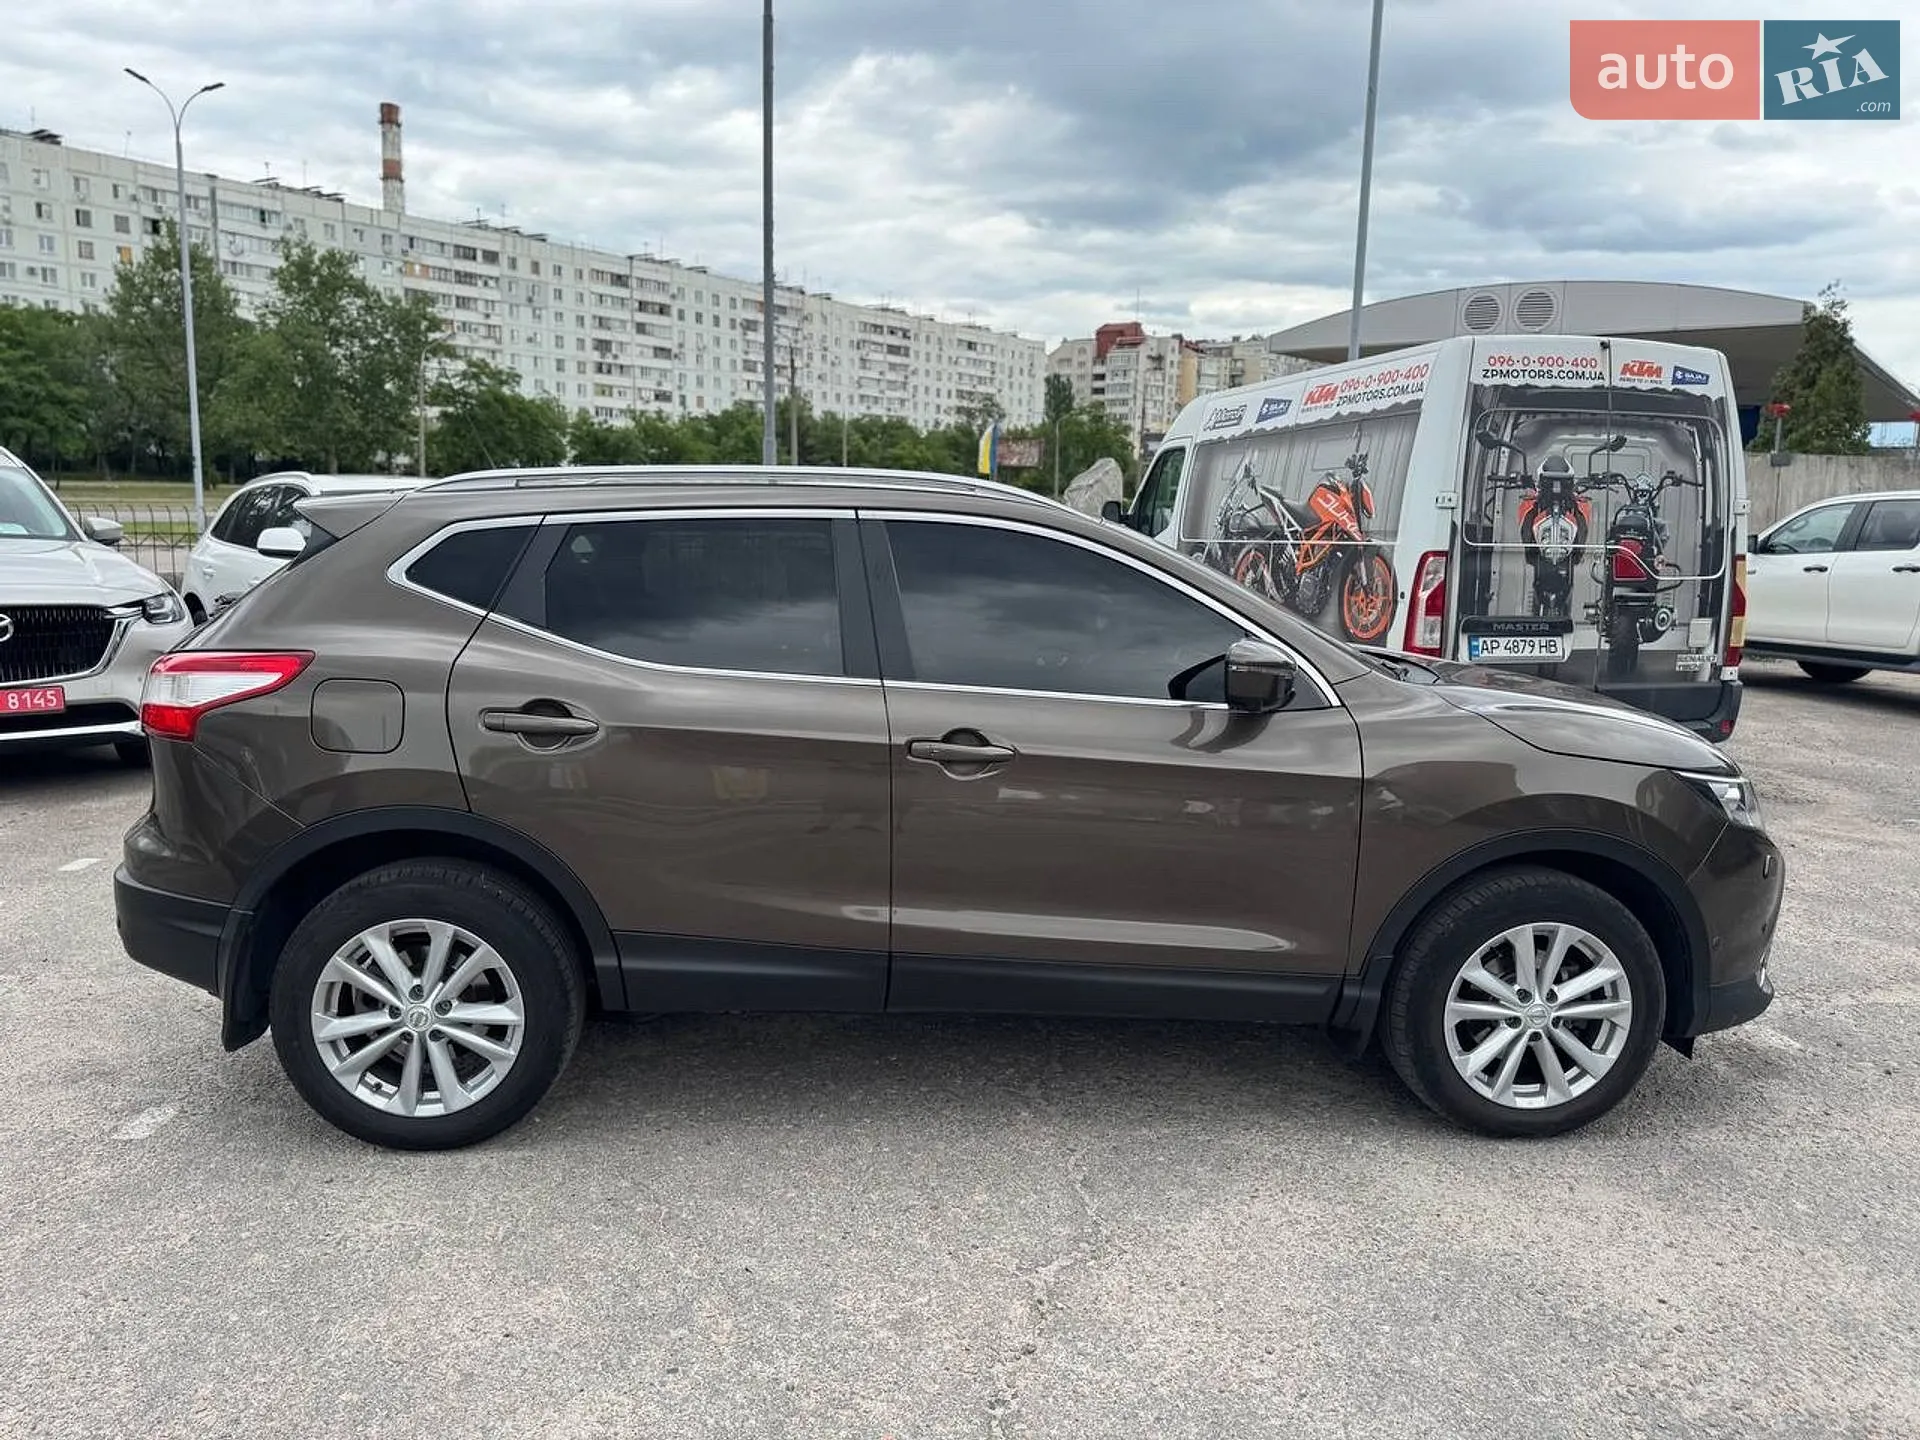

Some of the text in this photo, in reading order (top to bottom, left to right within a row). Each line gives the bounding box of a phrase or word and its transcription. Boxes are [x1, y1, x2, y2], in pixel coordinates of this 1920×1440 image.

[1482, 368, 1605, 381] ZPMOTORS.COM.UA
[1620, 360, 1663, 378] KTM
[1303, 383, 1339, 406] KTM
[1336, 381, 1424, 407] ZPMOTORS.COM.UA
[1492, 623, 1550, 632] MASTER
[1480, 639, 1558, 654] AP 4879 HB
[7, 689, 57, 710] 8145
